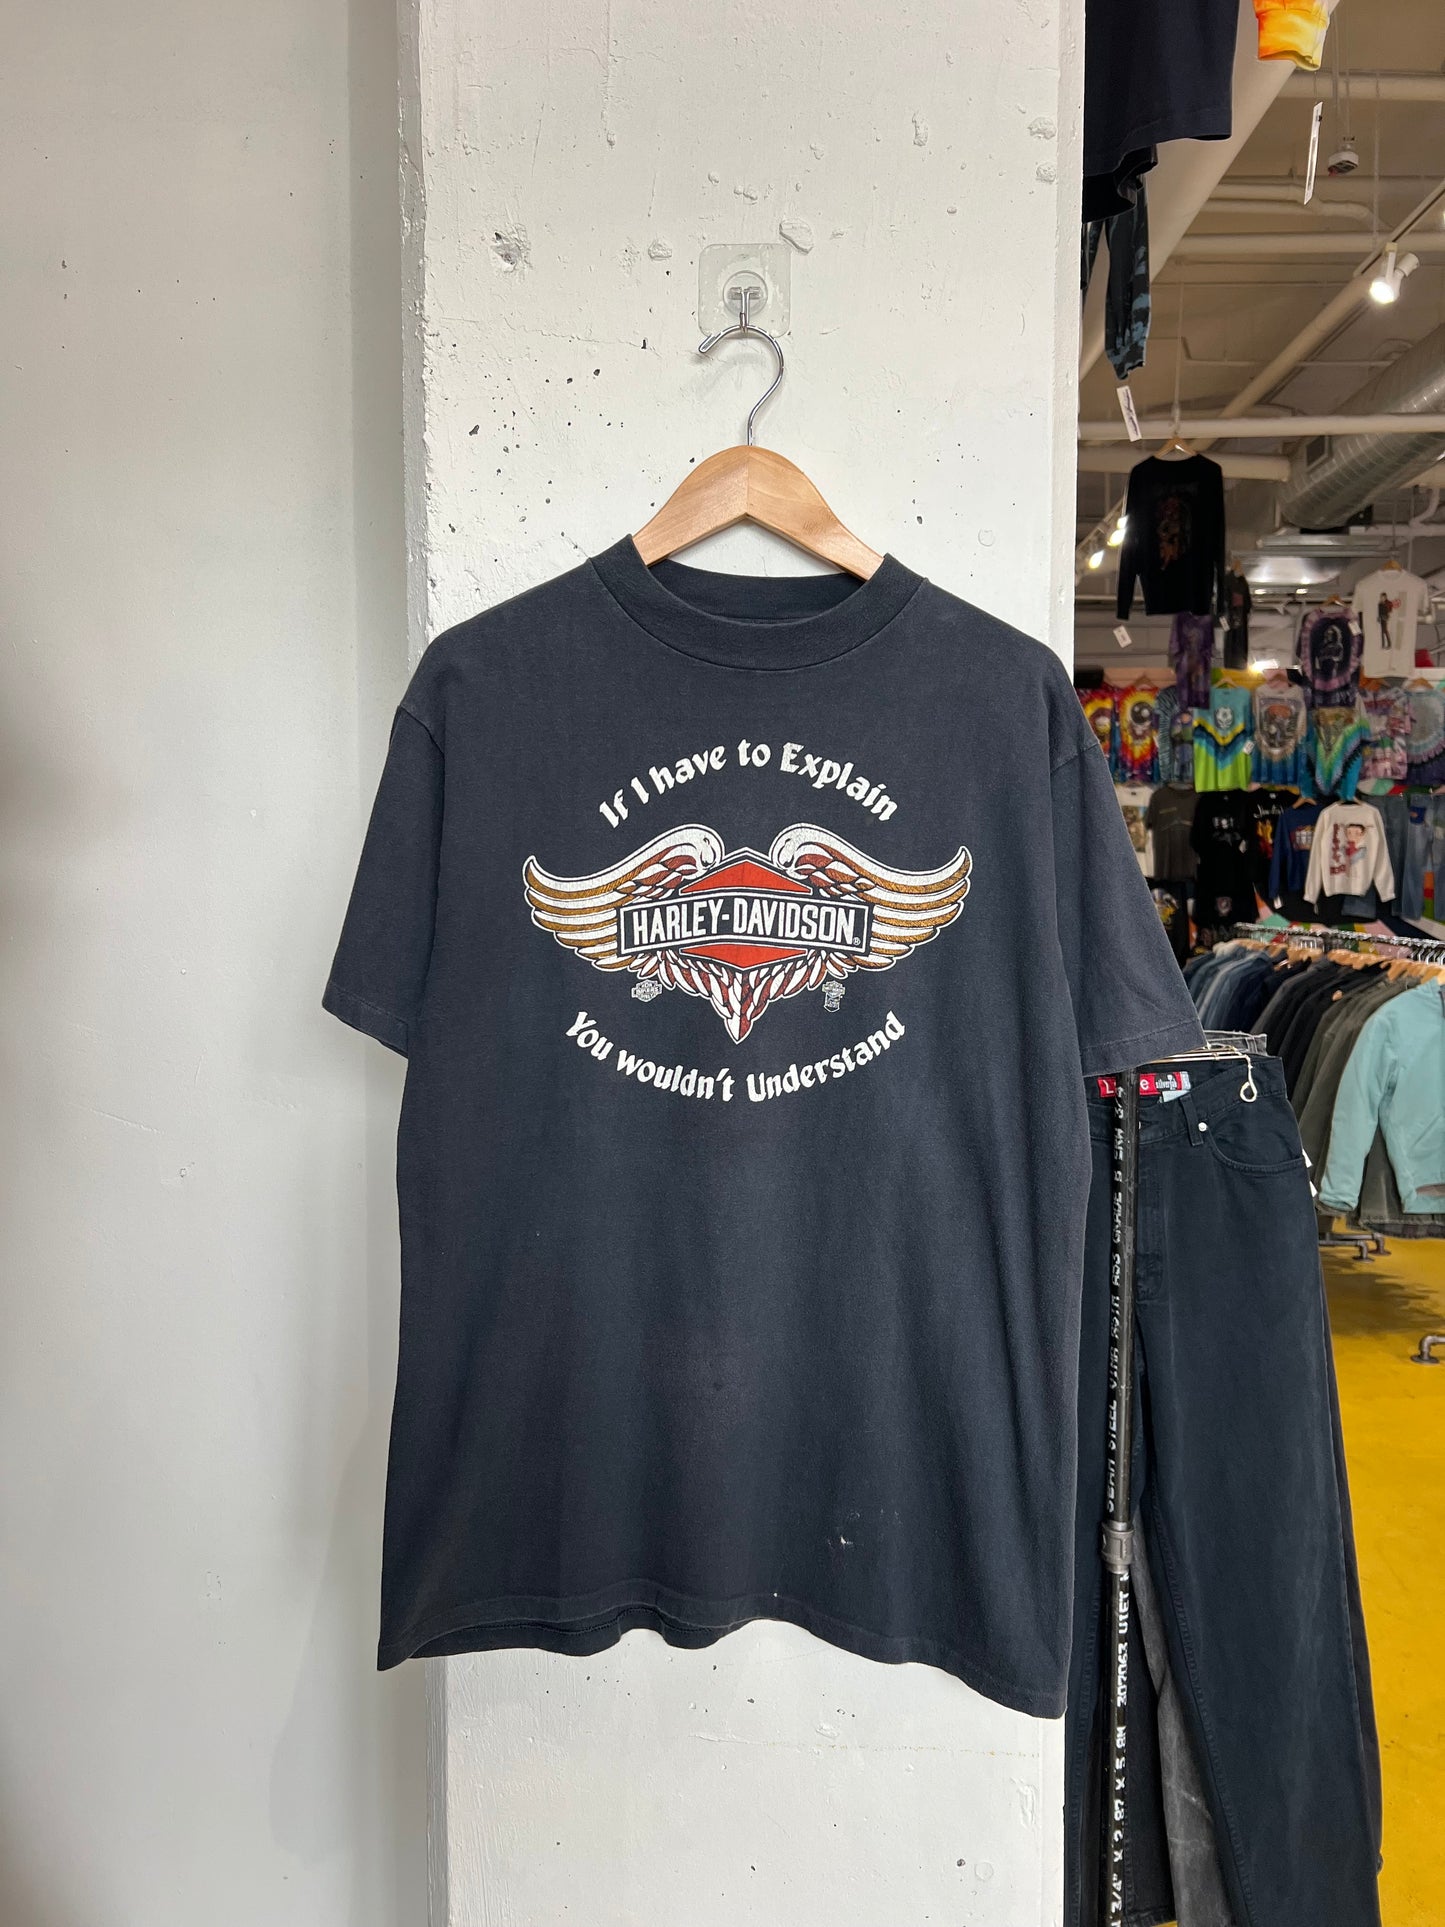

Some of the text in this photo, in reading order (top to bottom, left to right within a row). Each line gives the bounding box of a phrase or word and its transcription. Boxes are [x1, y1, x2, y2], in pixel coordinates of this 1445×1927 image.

[598, 738, 899, 829] If I have to Explain
[565, 1010, 906, 1102] You wouldn't Understand
